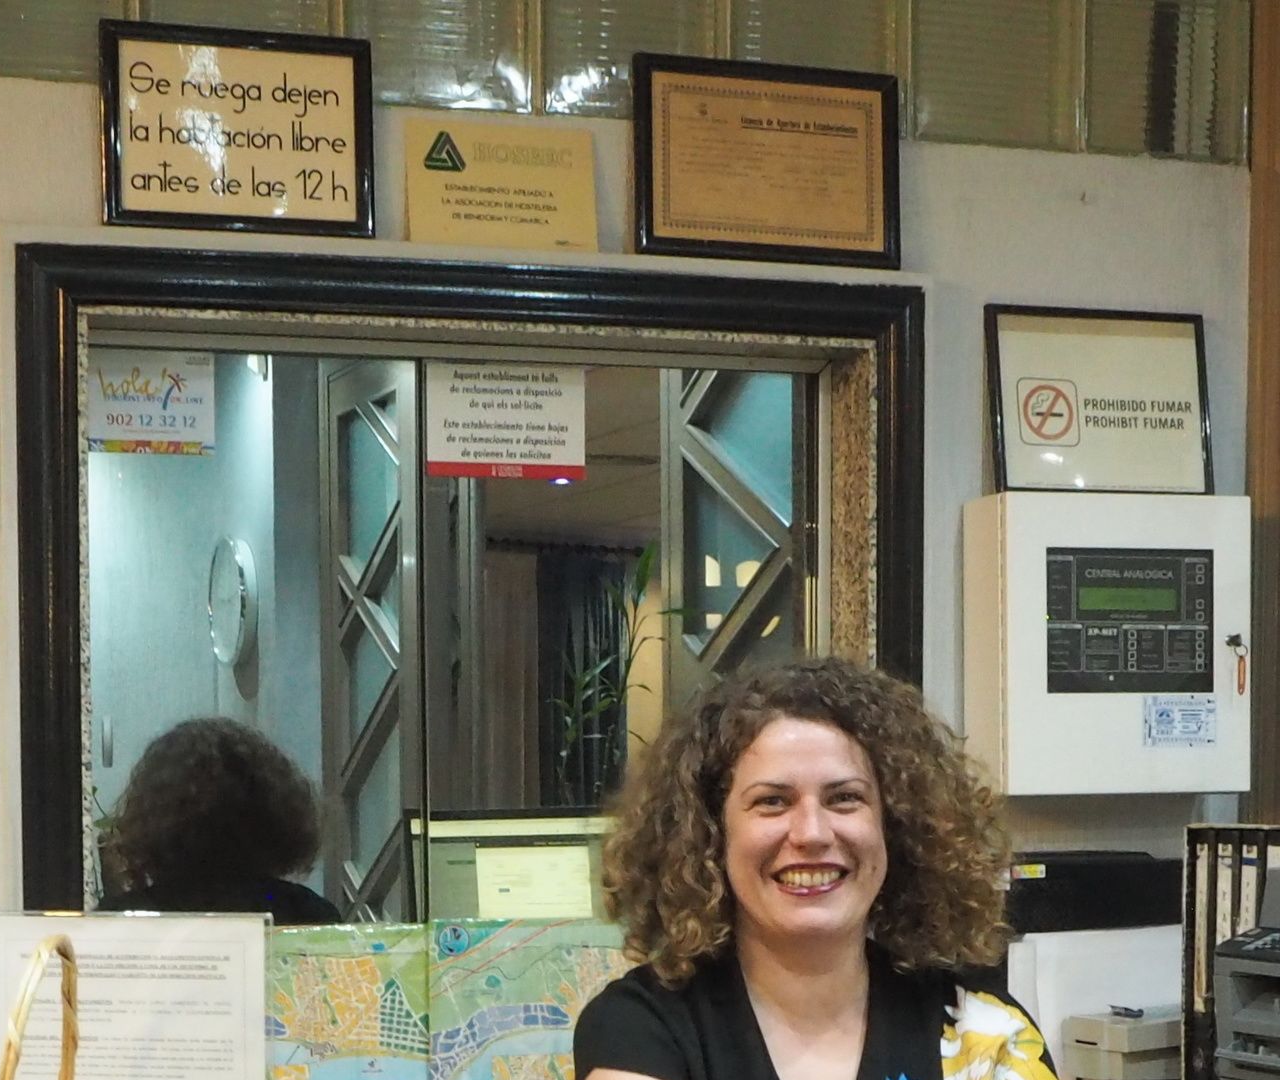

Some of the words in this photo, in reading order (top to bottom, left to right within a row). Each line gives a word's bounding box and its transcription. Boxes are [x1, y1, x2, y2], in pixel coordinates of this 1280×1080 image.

[129, 61, 171, 94] Se
[181, 79, 262, 113] ruega
[272, 72, 340, 117] dejen
[129, 110, 149, 142] la
[292, 121, 347, 153] libre
[131, 161, 199, 193] antes
[211, 163, 242, 195] de
[251, 166, 286, 198] las
[295, 169, 323, 201] 12
[332, 170, 348, 202] h
[450, 384, 459, 394] de
[469, 399, 479, 408] de
[482, 400, 494, 410] qui
[497, 401, 507, 409] els
[1083, 399, 1146, 412] PROHIBIDO
[1151, 400, 1192, 413] FUMAR
[106, 413, 133, 426] 902
[139, 414, 153, 427] 12
[159, 415, 176, 428] 32
[183, 415, 196, 429] 12
[444, 419, 459, 429] Este
[462, 420, 523, 432] establecimiento
[547, 422, 568, 434] hojas
[1085, 415, 1139, 429] PROHIBIT
[1143, 417, 1184, 430] FUMAR
[446, 434, 456, 443] de
[461, 449, 471, 458] de
[1085, 568, 1120, 579] CENTRAL
